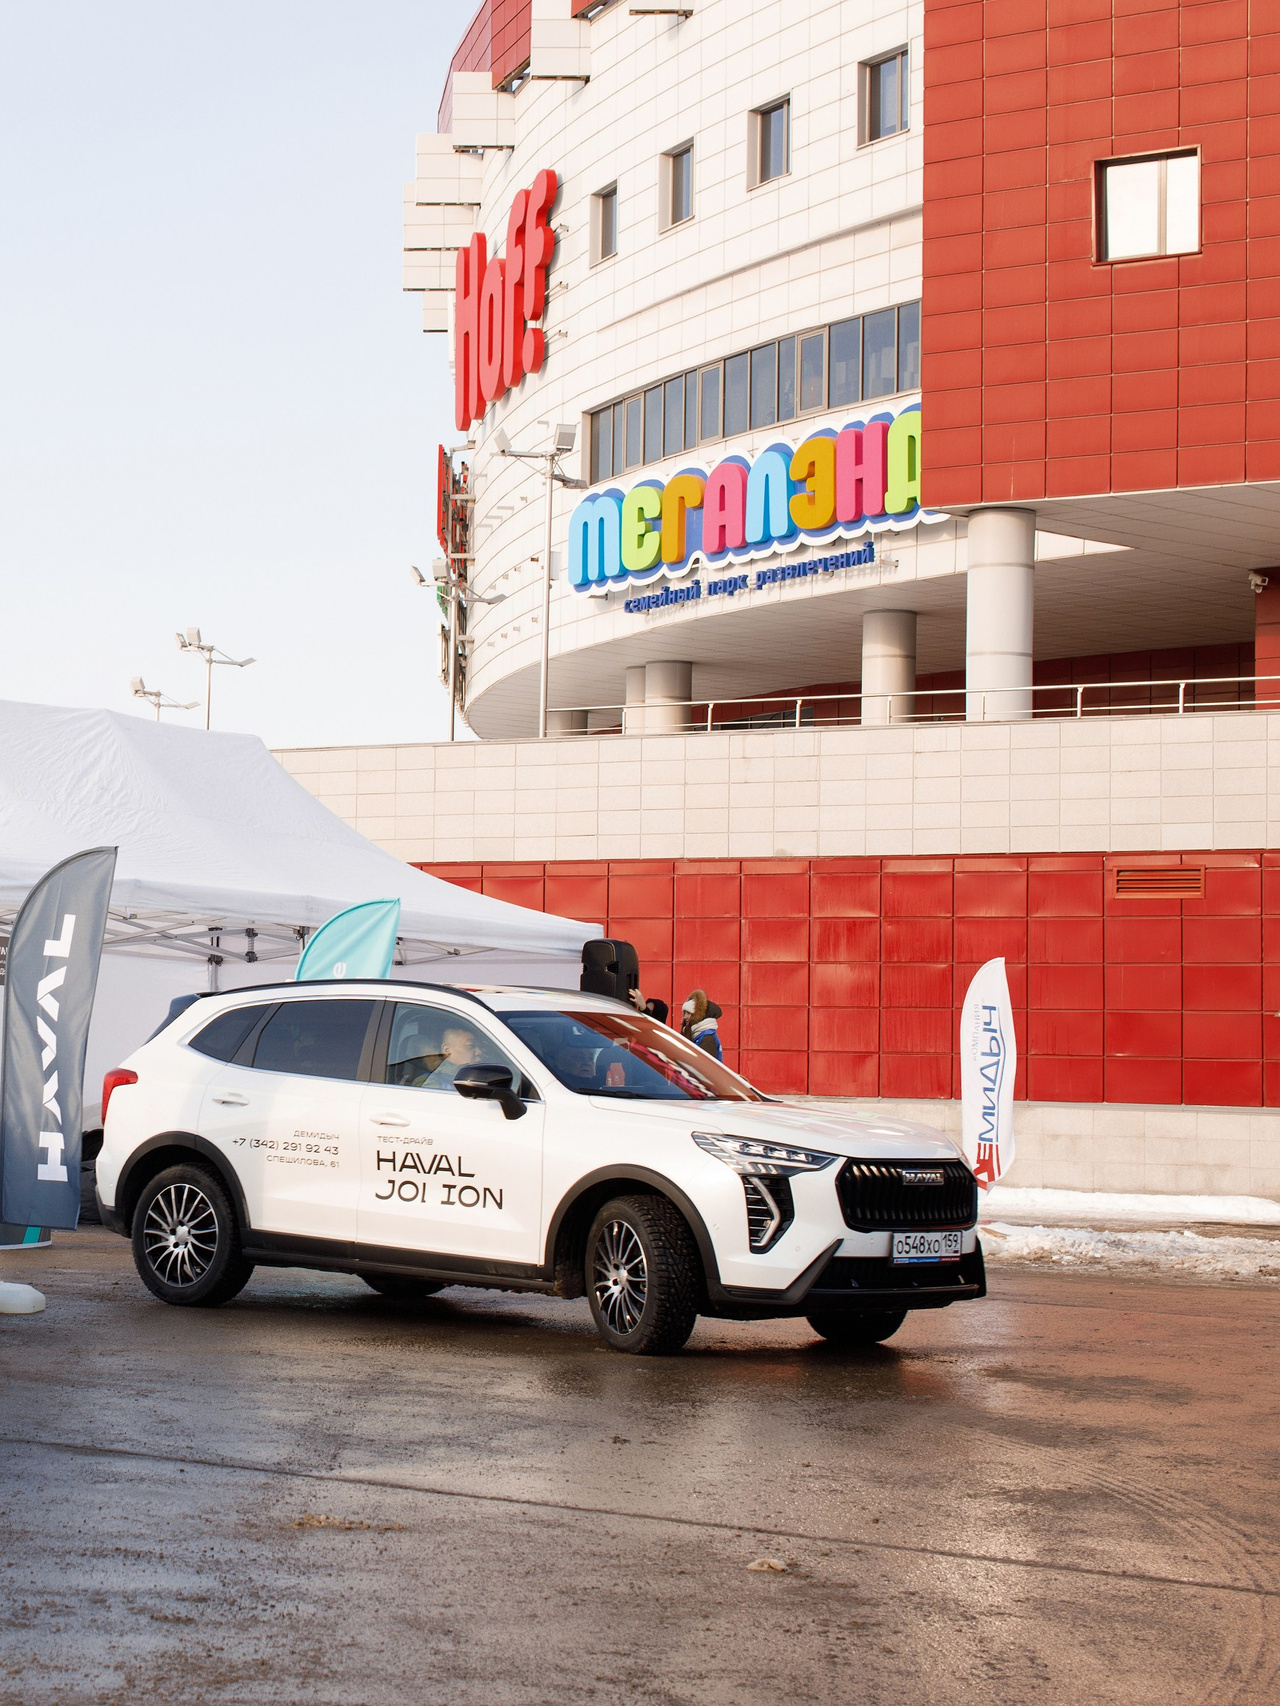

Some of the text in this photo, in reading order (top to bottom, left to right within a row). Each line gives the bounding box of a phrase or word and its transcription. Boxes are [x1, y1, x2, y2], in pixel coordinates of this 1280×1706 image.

[624, 541, 875, 613] семейный парк развлечений
[37, 914, 76, 1181] HAVAL
[293, 1130, 339, 1140] ДЕМИДЫЧ
[377, 1136, 433, 1145] ТЕСТ-ДРАЙВ
[232, 1138, 339, 1155] +7 (342) 291 92 43
[266, 1155, 328, 1167] СПЕШИЛОВА,
[376, 1150, 476, 1178] HAVAL
[943, 1233, 958, 1248] 159
